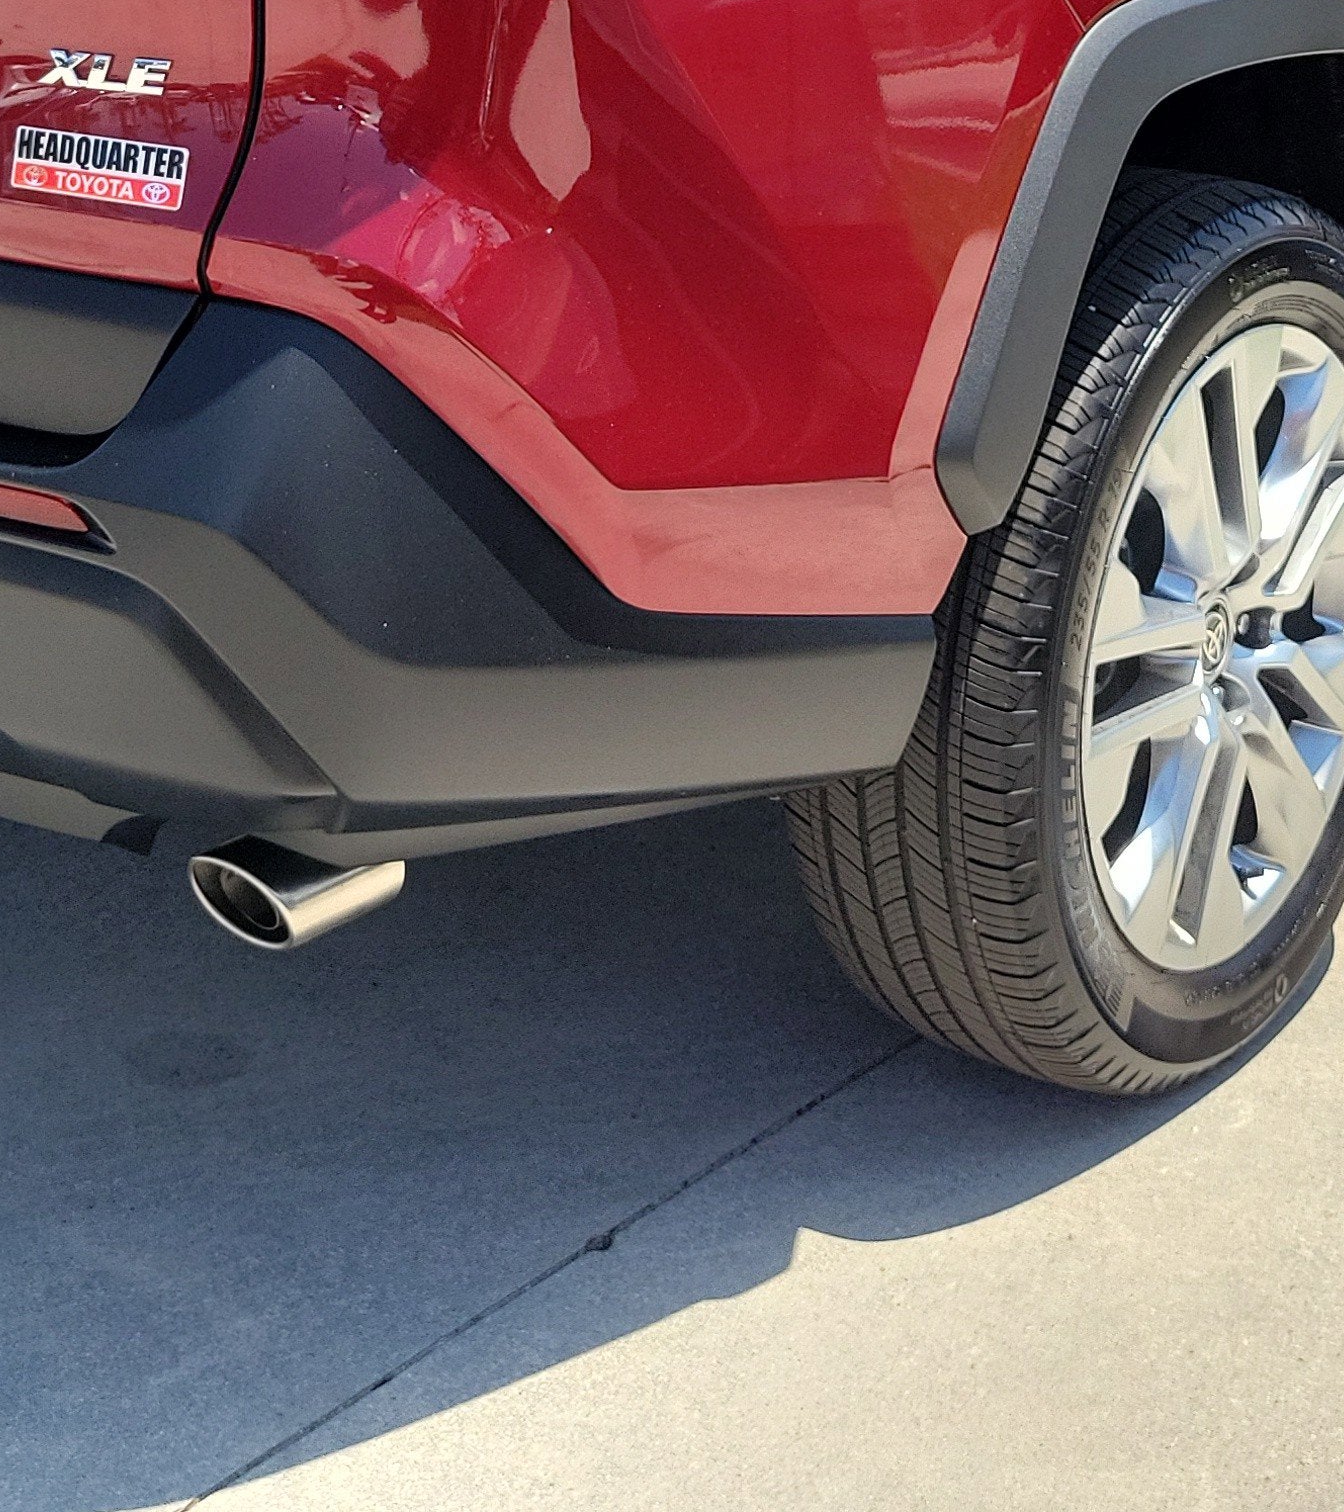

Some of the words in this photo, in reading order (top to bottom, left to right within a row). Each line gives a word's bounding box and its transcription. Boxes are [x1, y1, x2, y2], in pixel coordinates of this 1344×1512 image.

[37, 48, 172, 96] XLE
[18, 128, 185, 180] HEADQUARTER
[55, 171, 134, 200] TOYOTA
